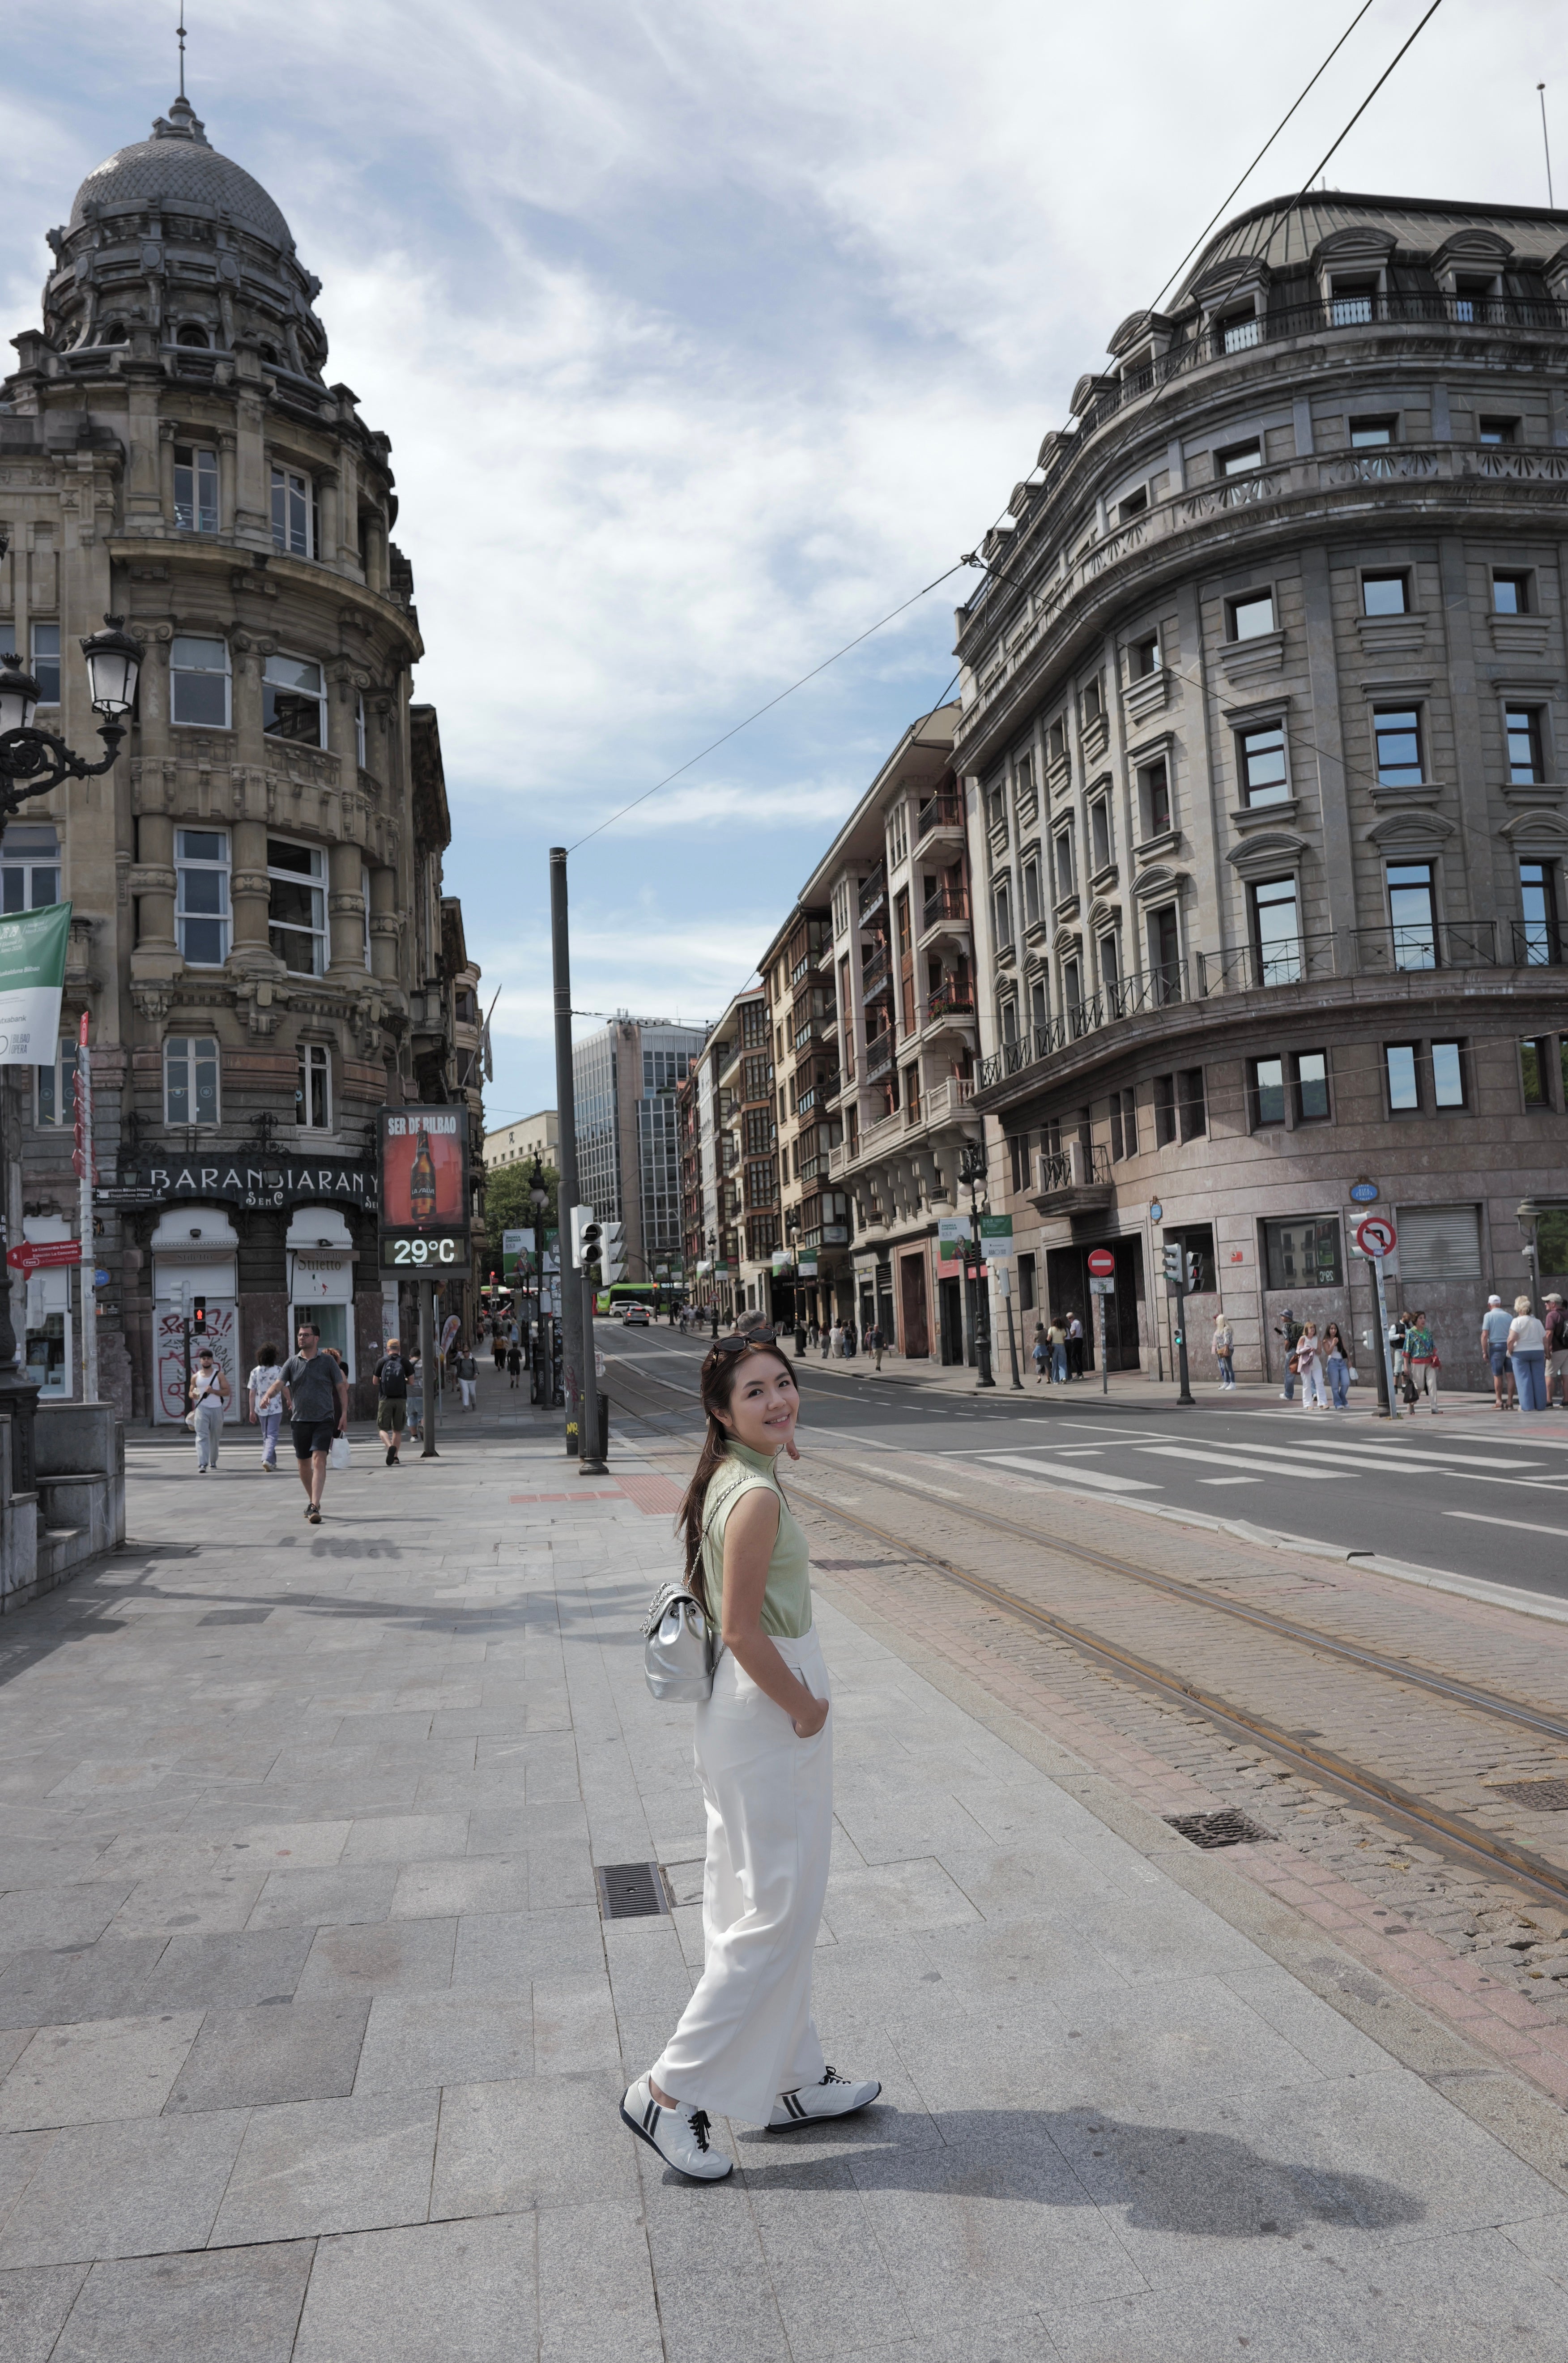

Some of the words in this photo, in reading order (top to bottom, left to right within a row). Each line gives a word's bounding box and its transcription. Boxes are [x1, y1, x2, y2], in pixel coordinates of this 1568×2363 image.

[0, 968, 23, 977] uskalduna
[13, 1033, 30, 1044] BILBAO
[11, 1044, 27, 1054] OPERA
[388, 1117, 406, 1135] SER
[409, 1117, 420, 1135] DE
[423, 1116, 456, 1134] BILBAO
[394, 1239, 454, 1264] 29°C
[298, 1259, 341, 1271] Stiletto
